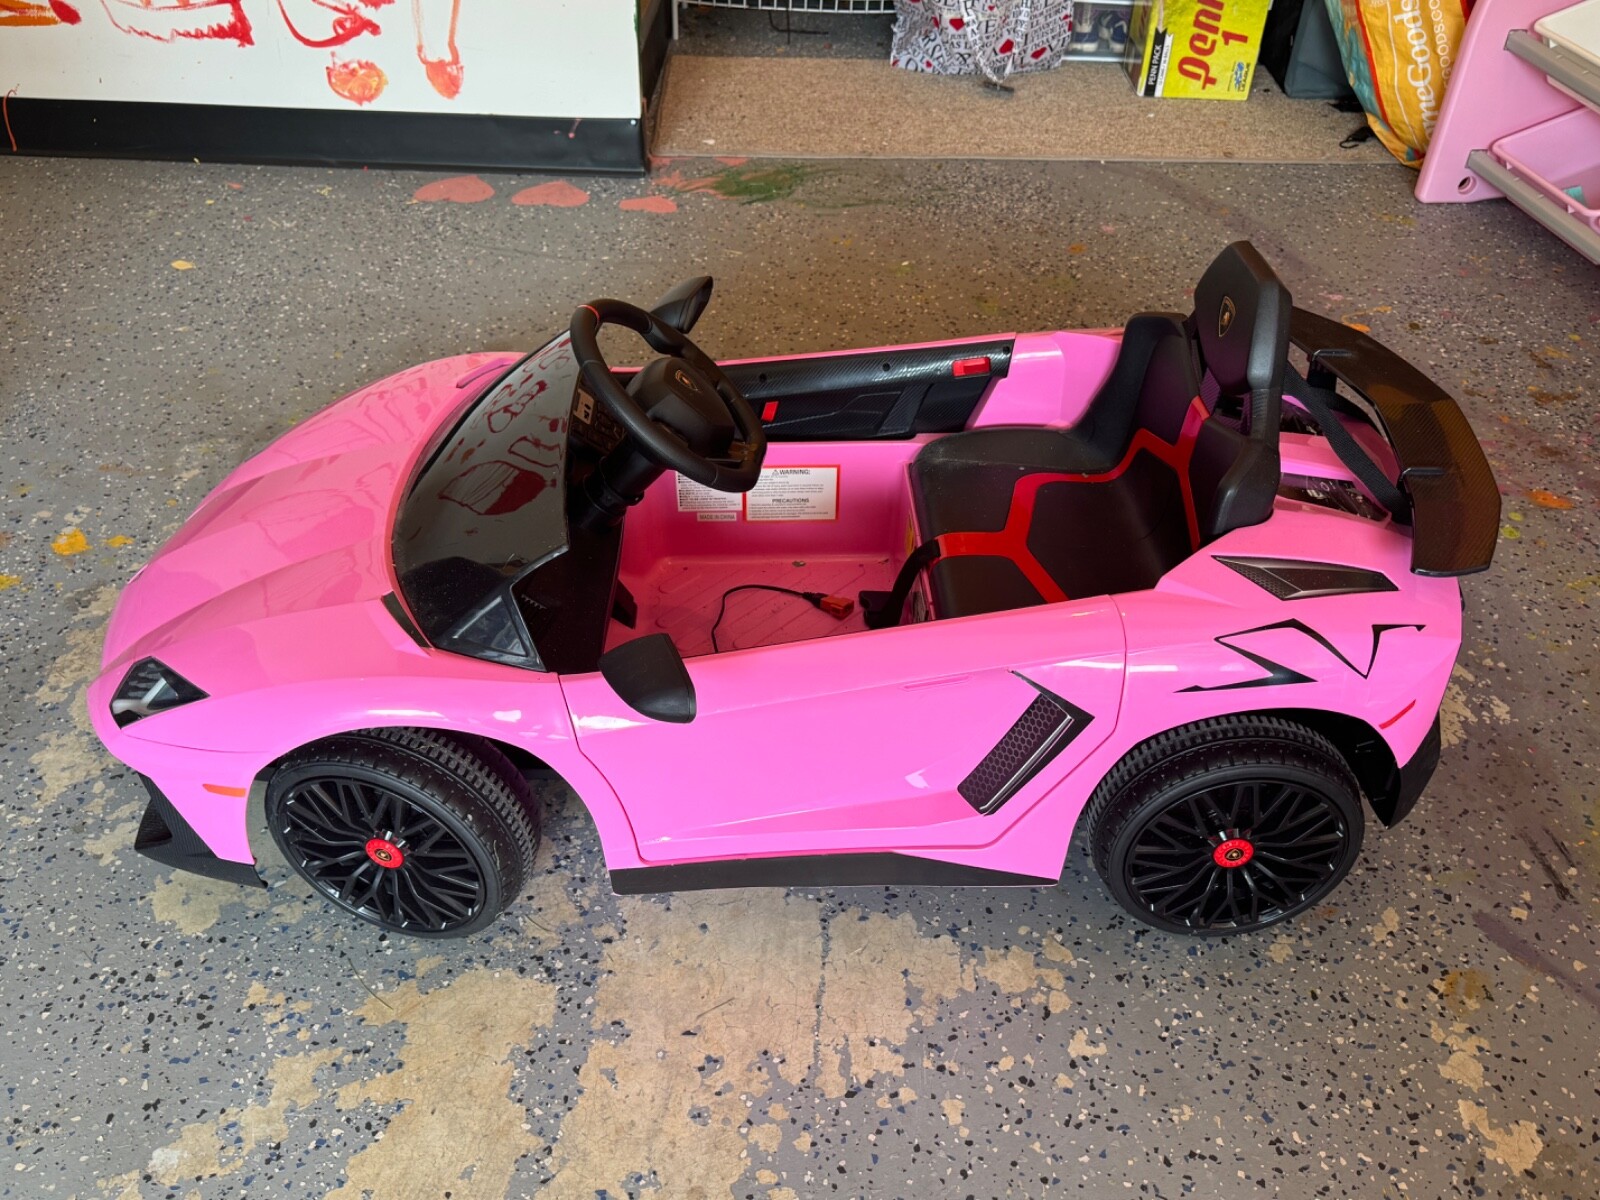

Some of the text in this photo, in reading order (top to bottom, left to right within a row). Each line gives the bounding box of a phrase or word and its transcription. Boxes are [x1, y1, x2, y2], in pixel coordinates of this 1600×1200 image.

[1221, 30, 1249, 46] 1
[1147, 44, 1162, 85] PENN PACK
[1394, 0, 1440, 141] meGoods
